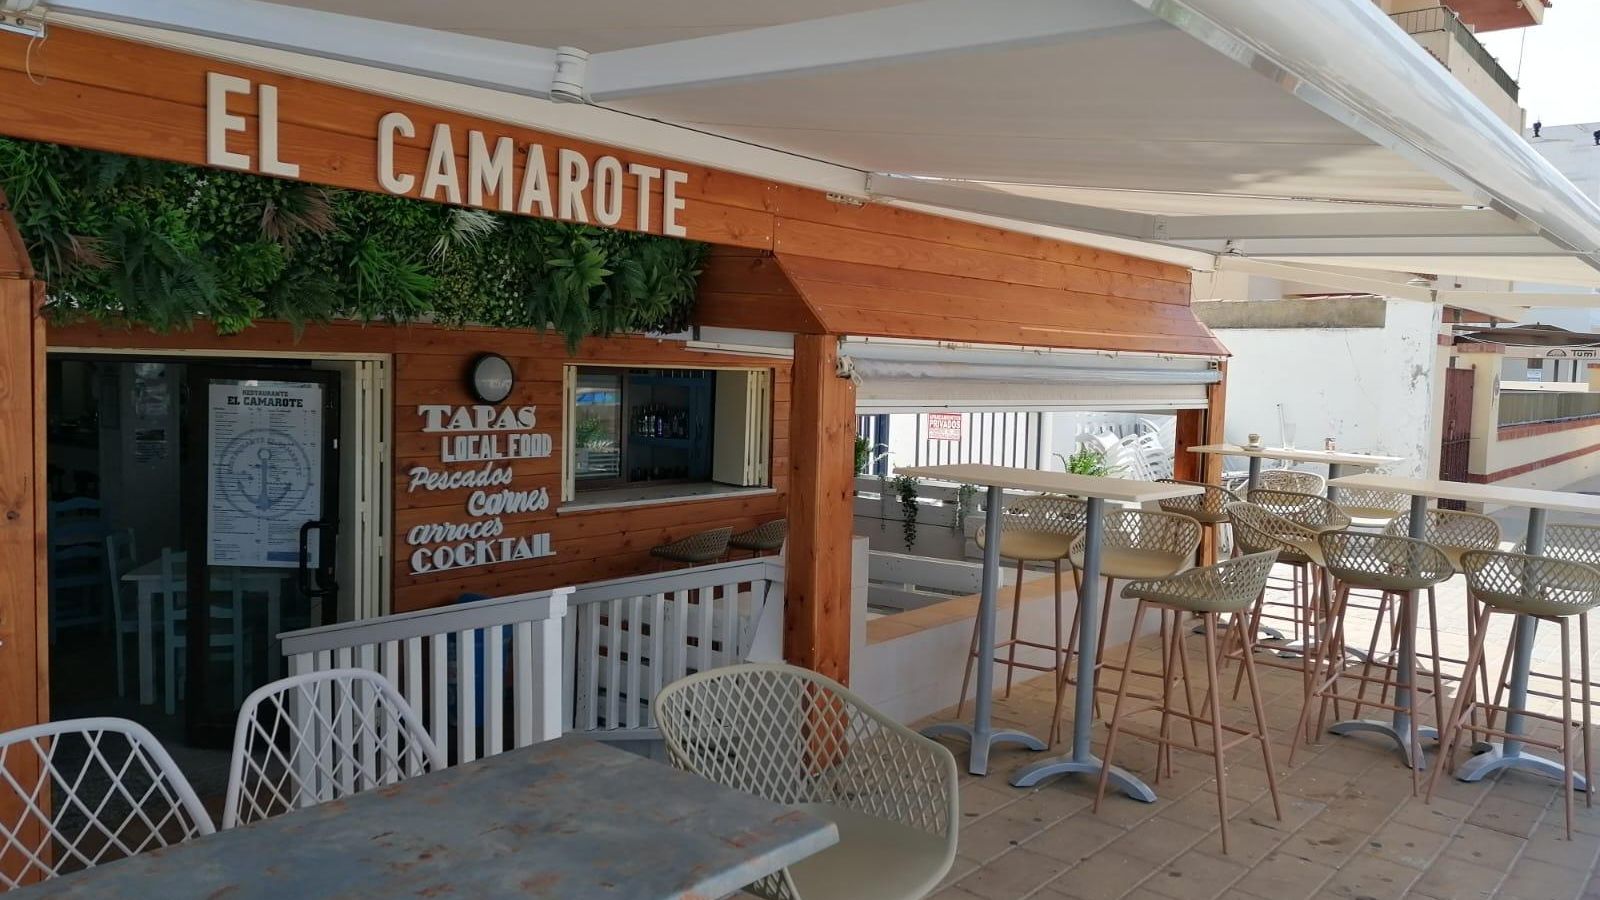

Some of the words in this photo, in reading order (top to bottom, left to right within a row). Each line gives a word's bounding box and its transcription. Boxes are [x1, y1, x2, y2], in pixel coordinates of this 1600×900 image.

[206, 71, 300, 178] EL
[377, 112, 689, 238] CAMAROTE
[227, 396, 241, 405] EL
[243, 397, 303, 408] CAMAROTE
[419, 405, 536, 432] TAPAS
[930, 419, 960, 430] PRIVADOS
[442, 435, 502, 462] LOCAL
[508, 434, 552, 458] FOOD
[409, 462, 512, 492] Pescados
[410, 533, 556, 574] COCKTAIL
